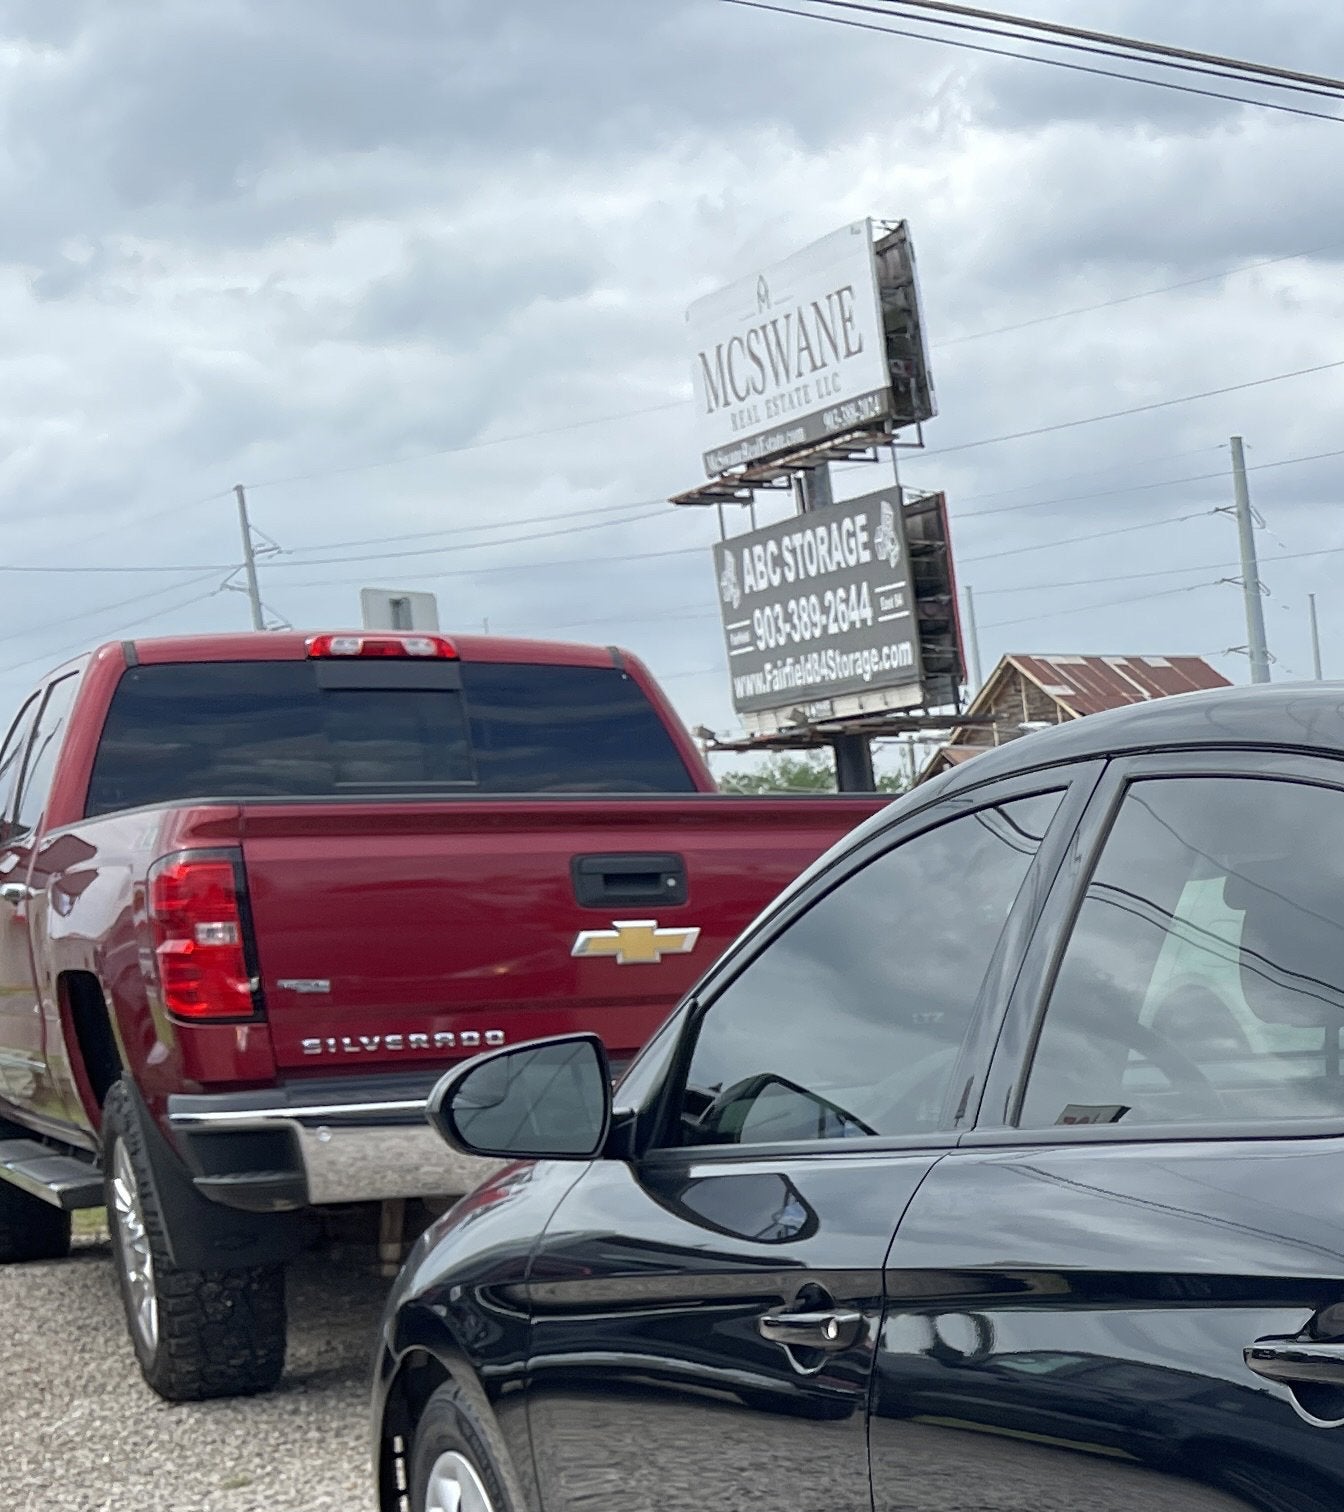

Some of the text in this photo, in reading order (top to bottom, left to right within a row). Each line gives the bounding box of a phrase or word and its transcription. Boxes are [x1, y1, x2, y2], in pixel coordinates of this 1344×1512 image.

[698, 285, 864, 414] MCSWANE
[731, 404, 762, 432] REAL
[765, 382, 812, 420] ESTATE
[817, 372, 842, 400] LLC
[742, 513, 872, 594] ABC STORAGE
[753, 581, 873, 651] 903-389-2644
[301, 1029, 505, 1055] SILVERADO
